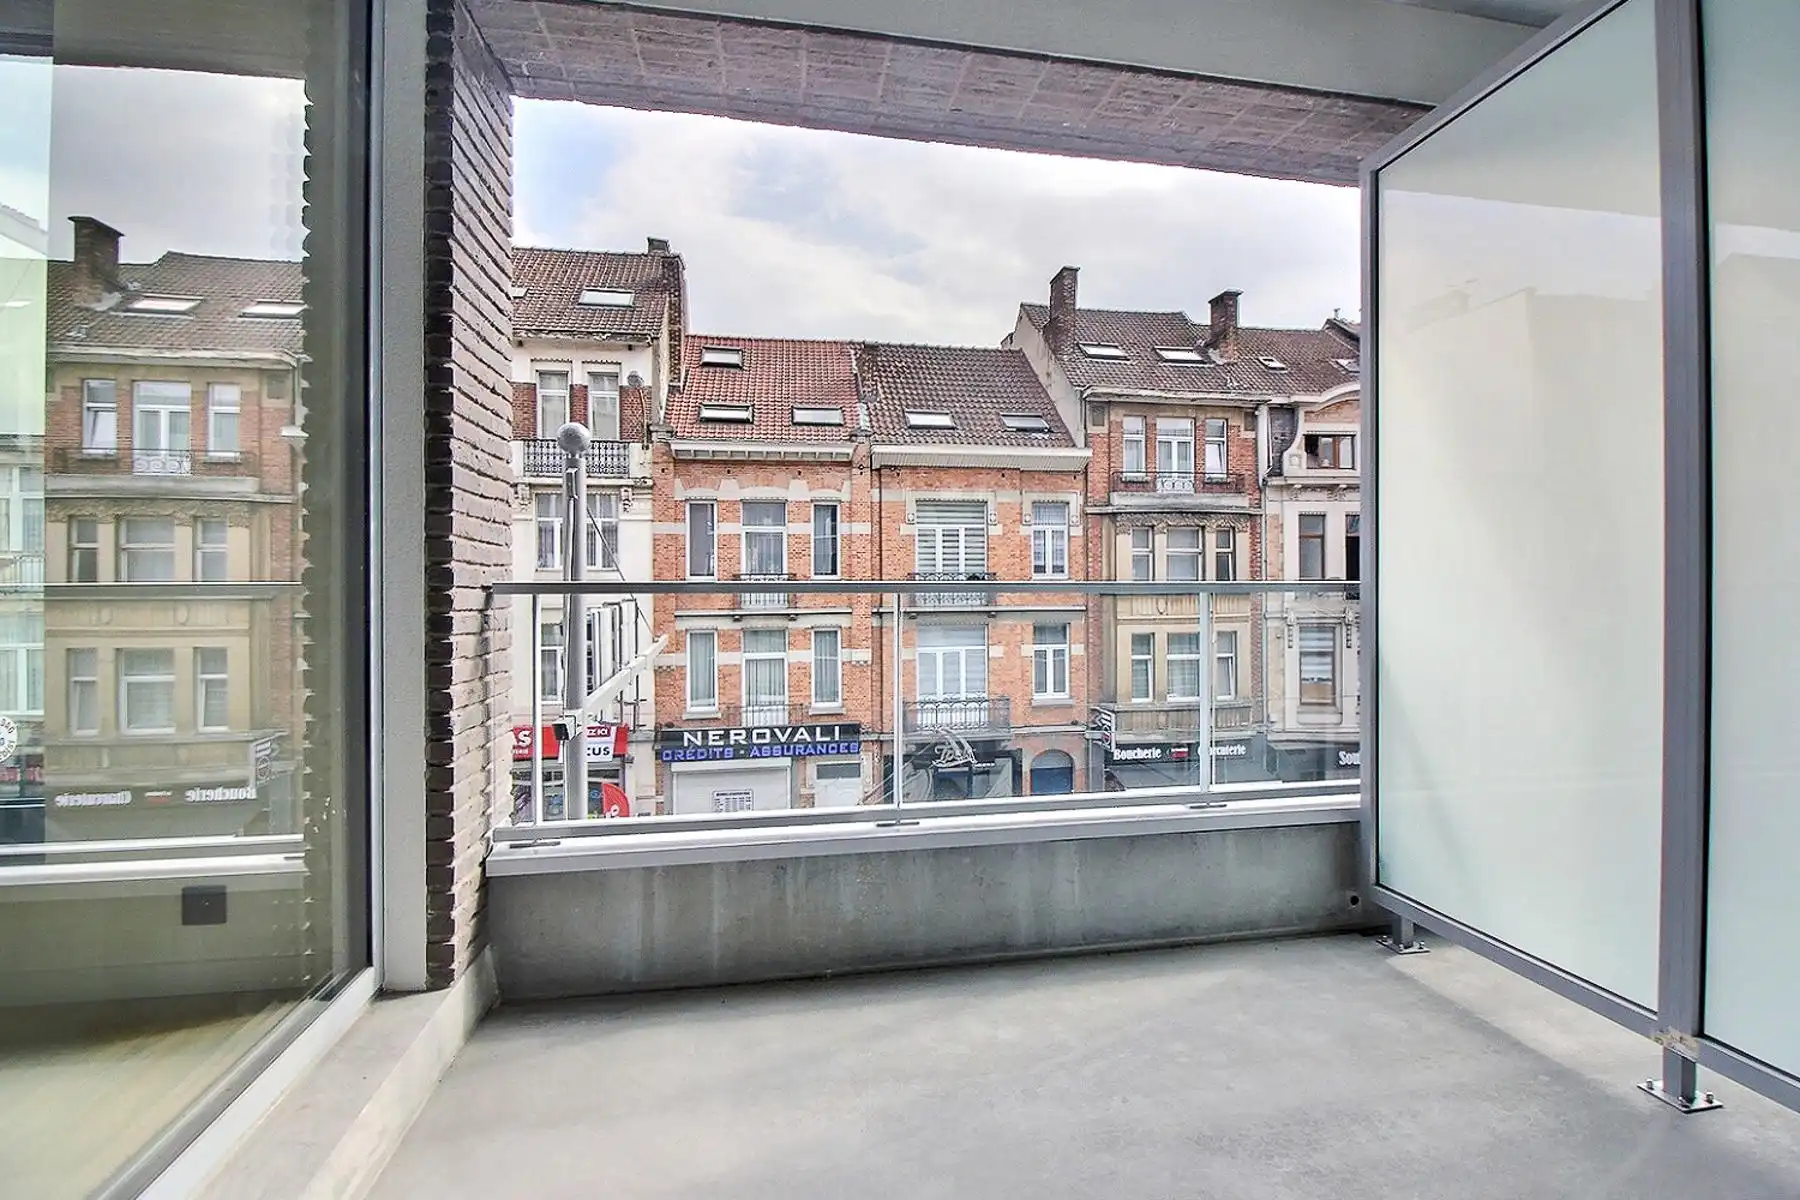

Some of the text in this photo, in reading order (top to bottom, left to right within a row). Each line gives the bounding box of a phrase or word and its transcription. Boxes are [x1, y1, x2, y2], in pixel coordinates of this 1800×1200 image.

[683, 726, 840, 746] NEROVALI
[750, 742, 859, 758] ASSURANCES
[1113, 747, 1162, 760] Boucherie
